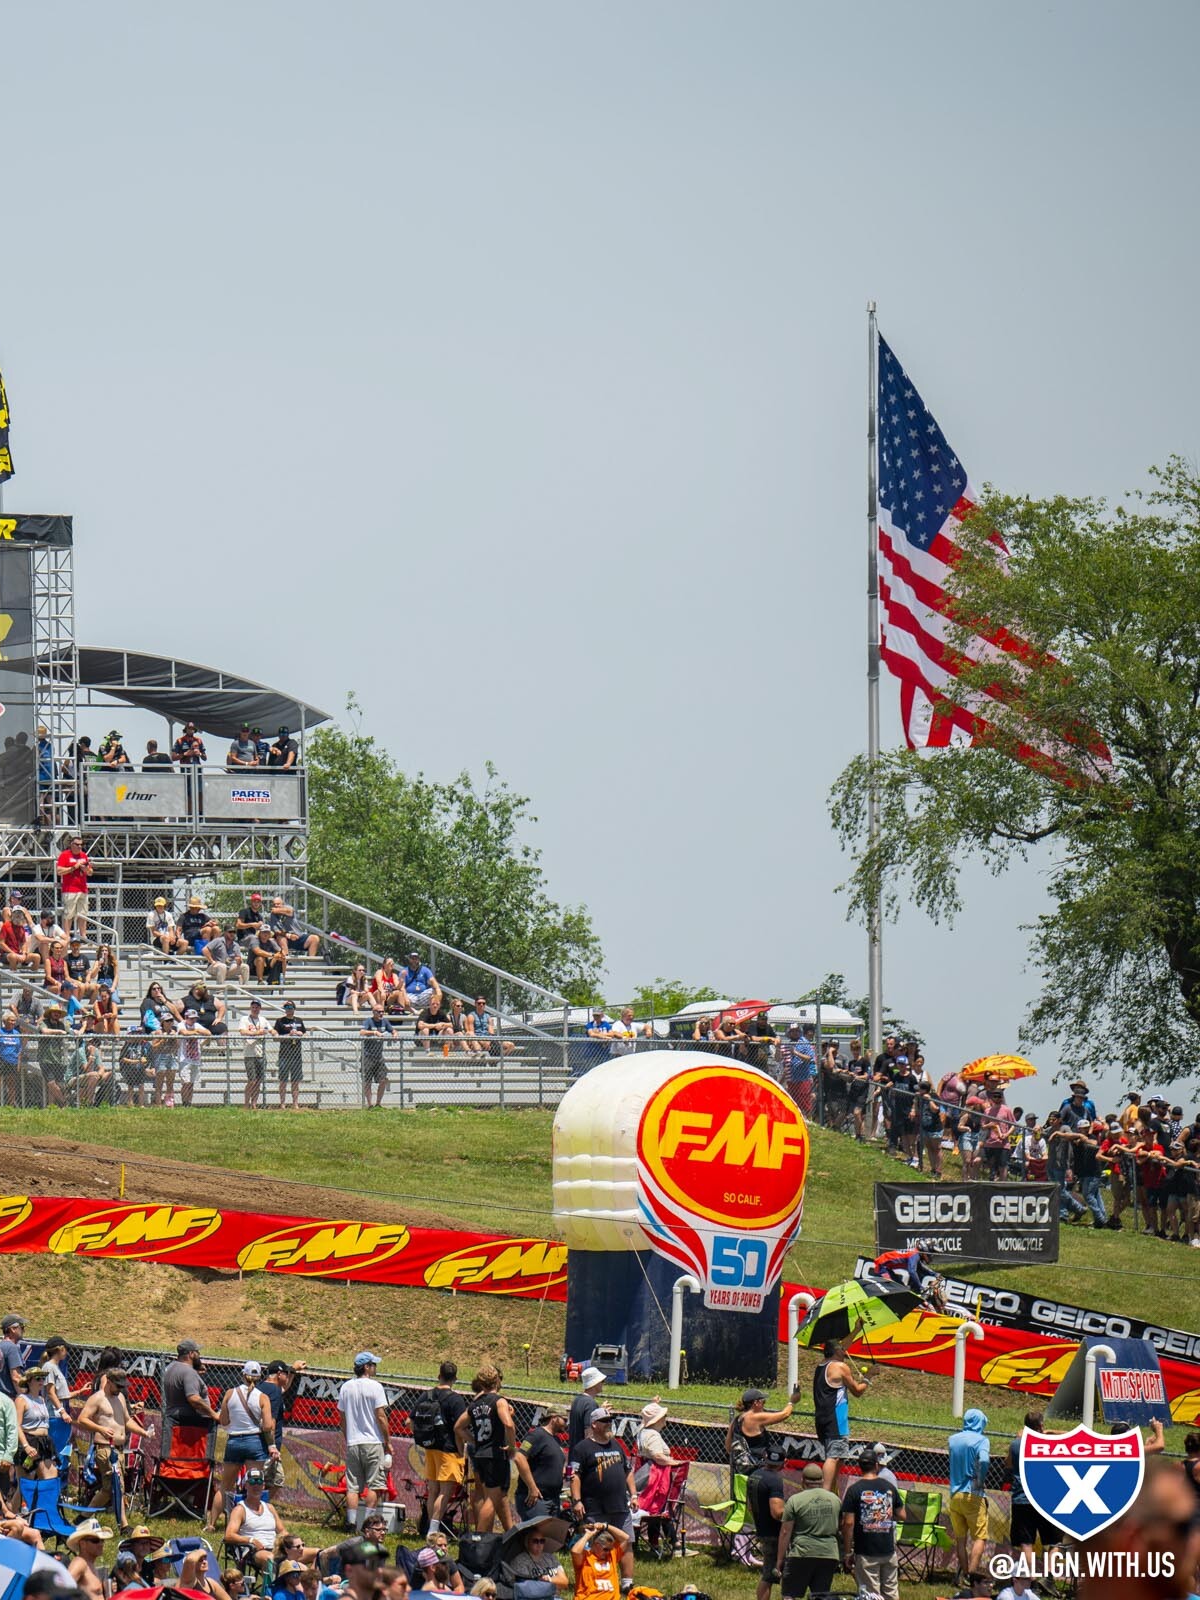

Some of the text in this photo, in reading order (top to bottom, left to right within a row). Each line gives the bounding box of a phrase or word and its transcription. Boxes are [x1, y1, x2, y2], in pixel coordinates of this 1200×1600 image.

[125, 792, 157, 801] thor
[231, 790, 270, 798] PARTS
[659, 1109, 802, 1170] FMF
[723, 1192, 736, 1204] SO
[895, 1194, 971, 1224] GEICO
[990, 1195, 1050, 1224] GEICO
[53, 1207, 218, 1254] FMF
[907, 1237, 962, 1252] MOCYCLE
[997, 1237, 1043, 1251] MOTORCYCLE
[240, 1224, 407, 1271] FMF
[711, 1235, 768, 1288] 50
[710, 1290, 730, 1305] YEARS
[741, 1292, 761, 1308] POWER
[1031, 1300, 1132, 1339] GEICO
